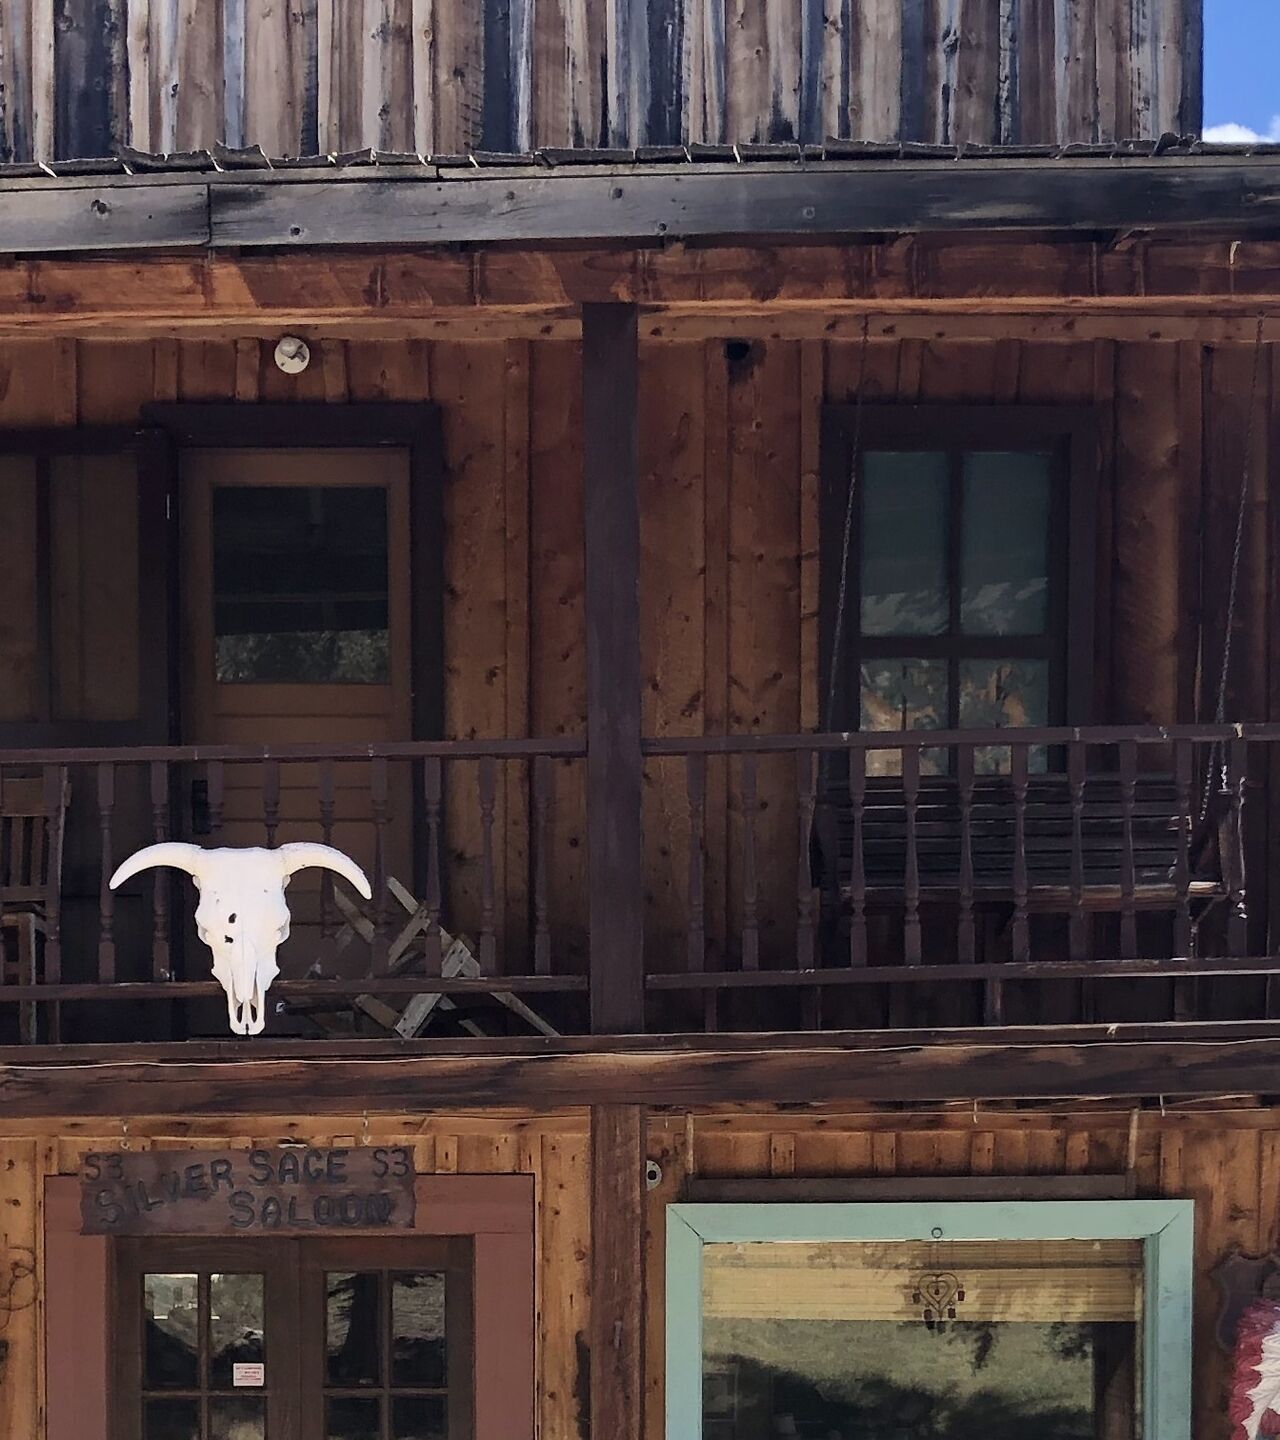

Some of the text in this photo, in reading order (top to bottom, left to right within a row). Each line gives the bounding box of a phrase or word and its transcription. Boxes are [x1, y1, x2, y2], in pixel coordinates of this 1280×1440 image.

[95, 1149, 349, 1225] SILVER SAGE
[228, 1190, 393, 1229] SALOON
